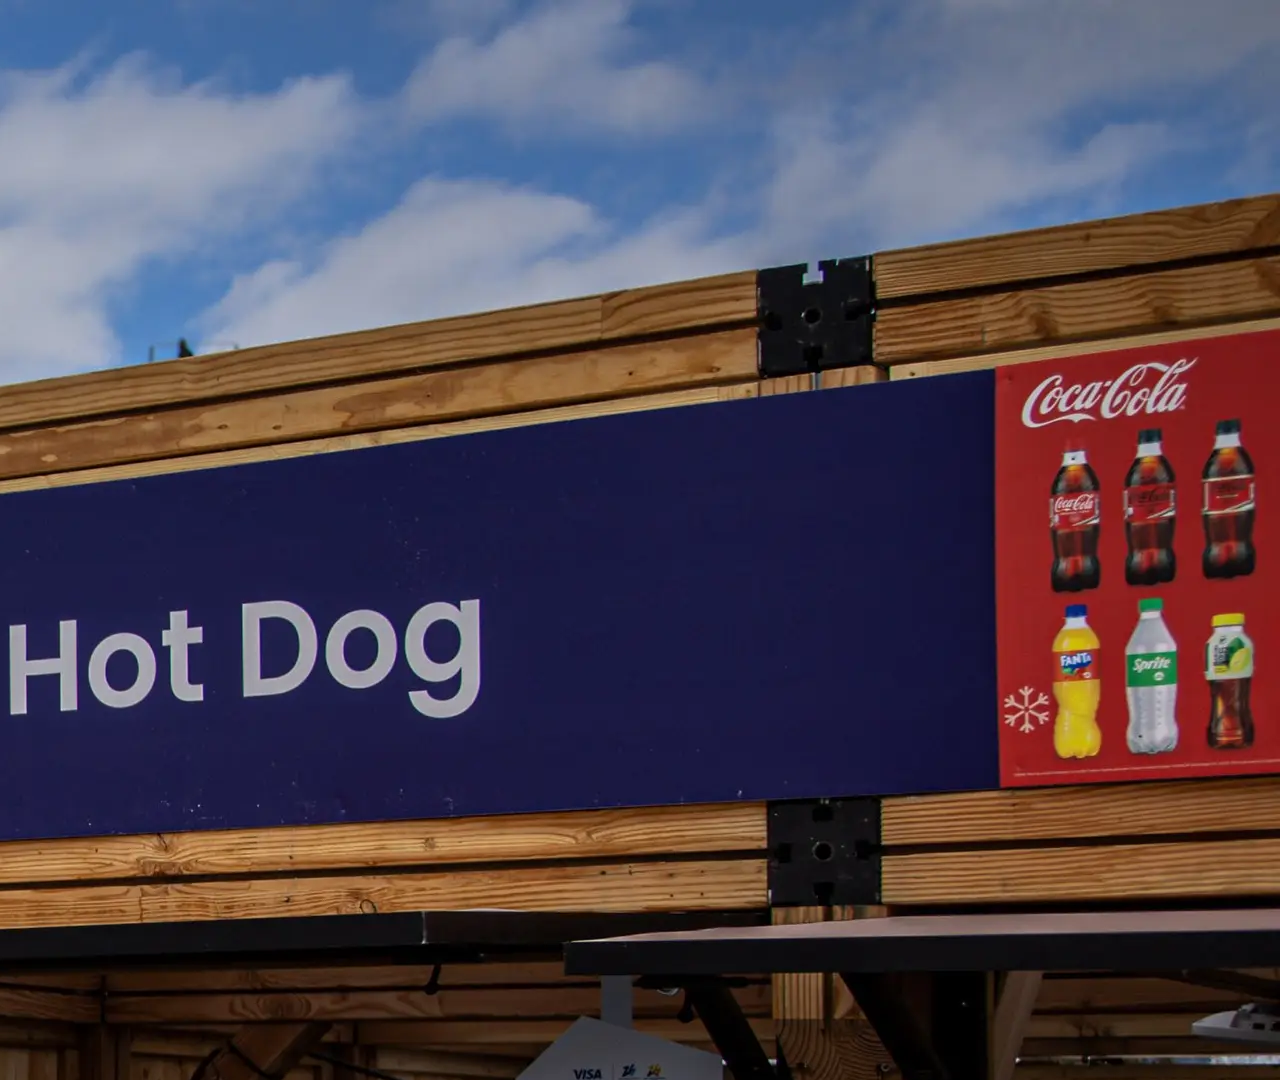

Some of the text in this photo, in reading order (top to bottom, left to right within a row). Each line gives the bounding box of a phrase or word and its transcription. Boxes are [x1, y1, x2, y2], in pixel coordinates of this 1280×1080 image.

[1021, 357, 1199, 428] Coca-Cola
[9, 609, 204, 716] Hot
[242, 598, 481, 718] Dog
[1132, 656, 1171, 673] Sprite
[573, 1068, 603, 1080] VISA
